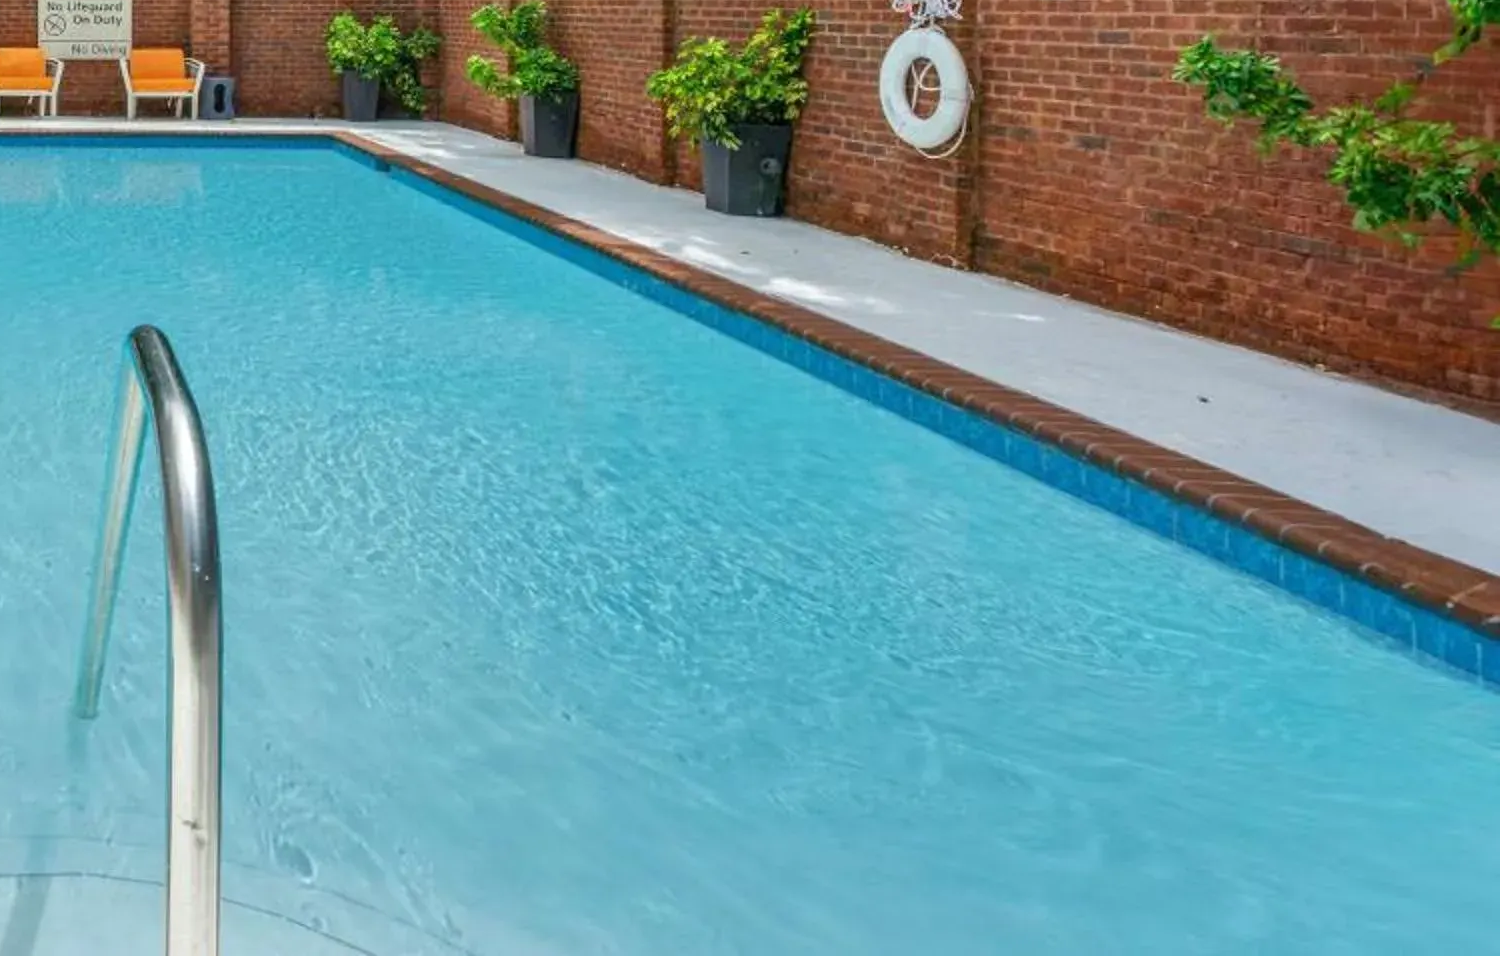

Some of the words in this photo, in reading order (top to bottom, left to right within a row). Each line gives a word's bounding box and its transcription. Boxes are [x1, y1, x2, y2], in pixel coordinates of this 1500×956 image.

[47, 1, 63, 11] No
[67, 1, 123, 13] Lifeguard
[73, 15, 90, 25] On
[94, 15, 123, 26] Duty
